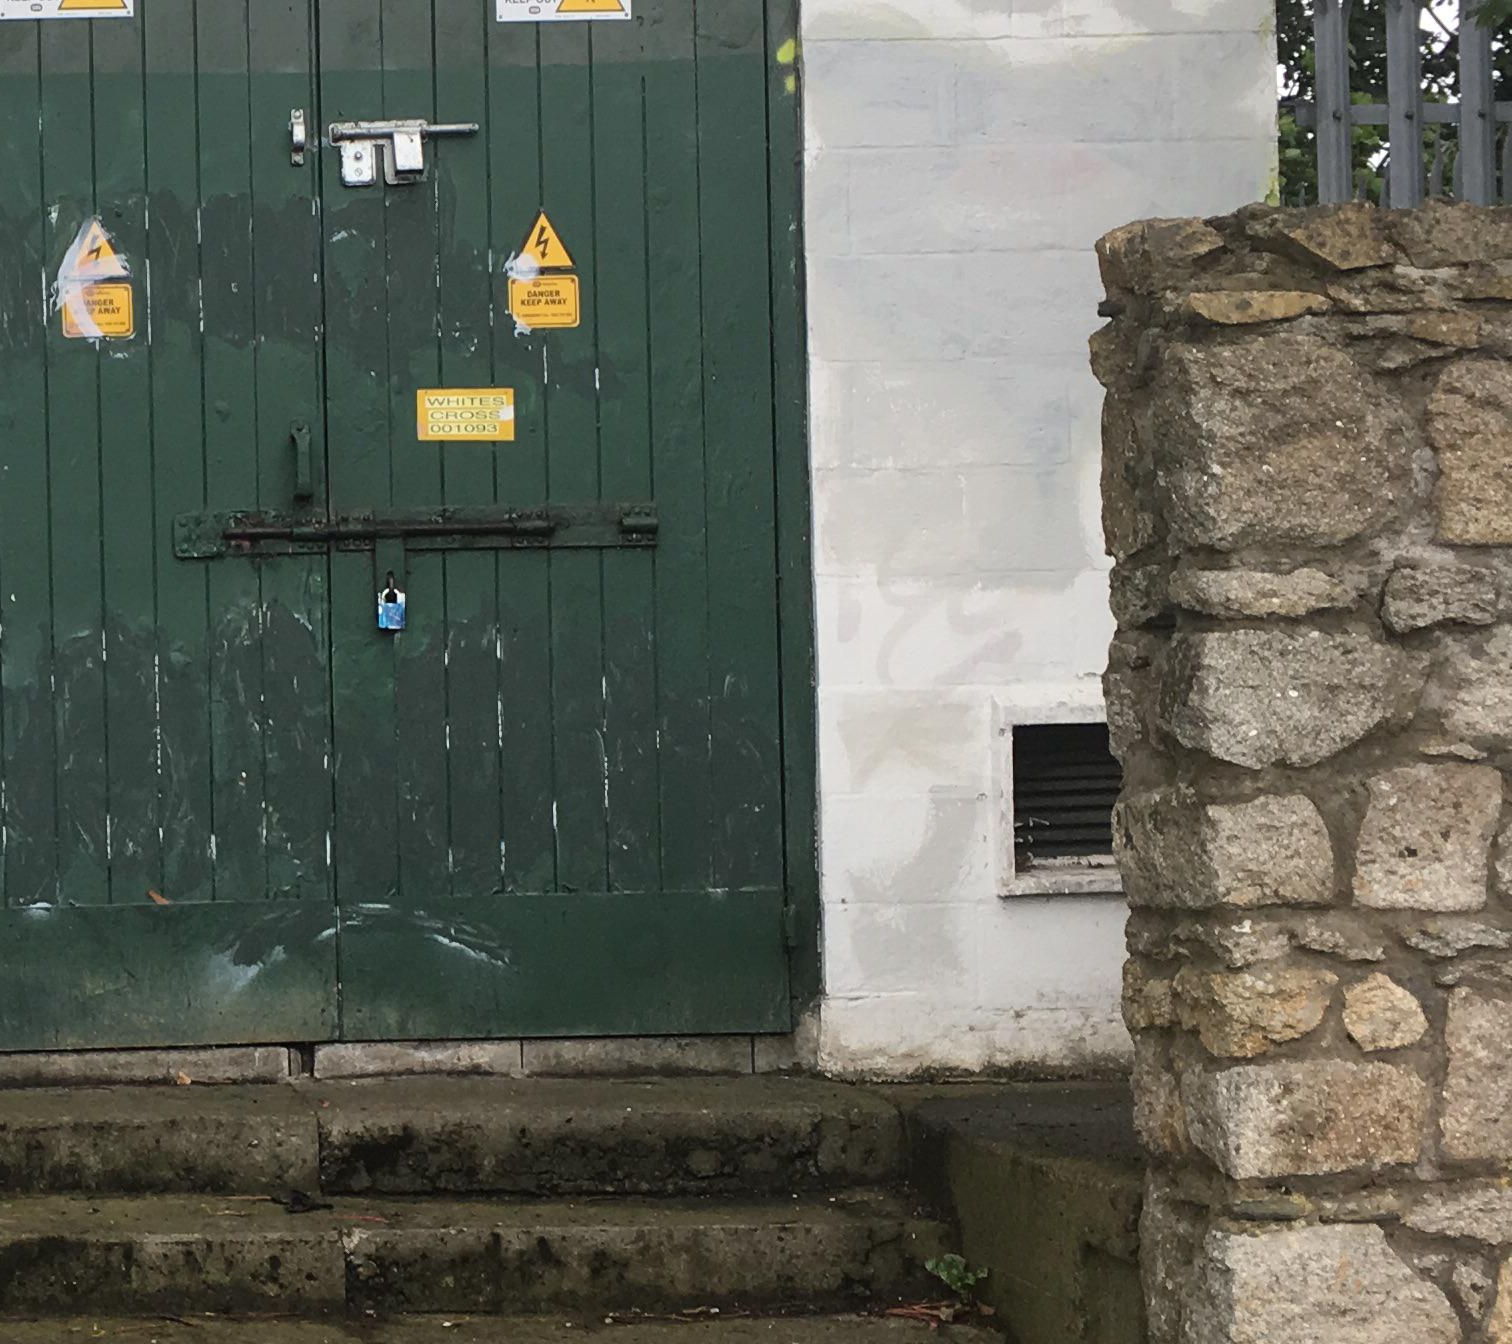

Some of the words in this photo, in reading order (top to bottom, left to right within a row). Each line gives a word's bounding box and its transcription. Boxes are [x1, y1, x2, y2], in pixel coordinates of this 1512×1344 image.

[428, 397, 504, 406] WHITES
[430, 411, 500, 420] CROSS
[431, 424, 498, 433] 001093
